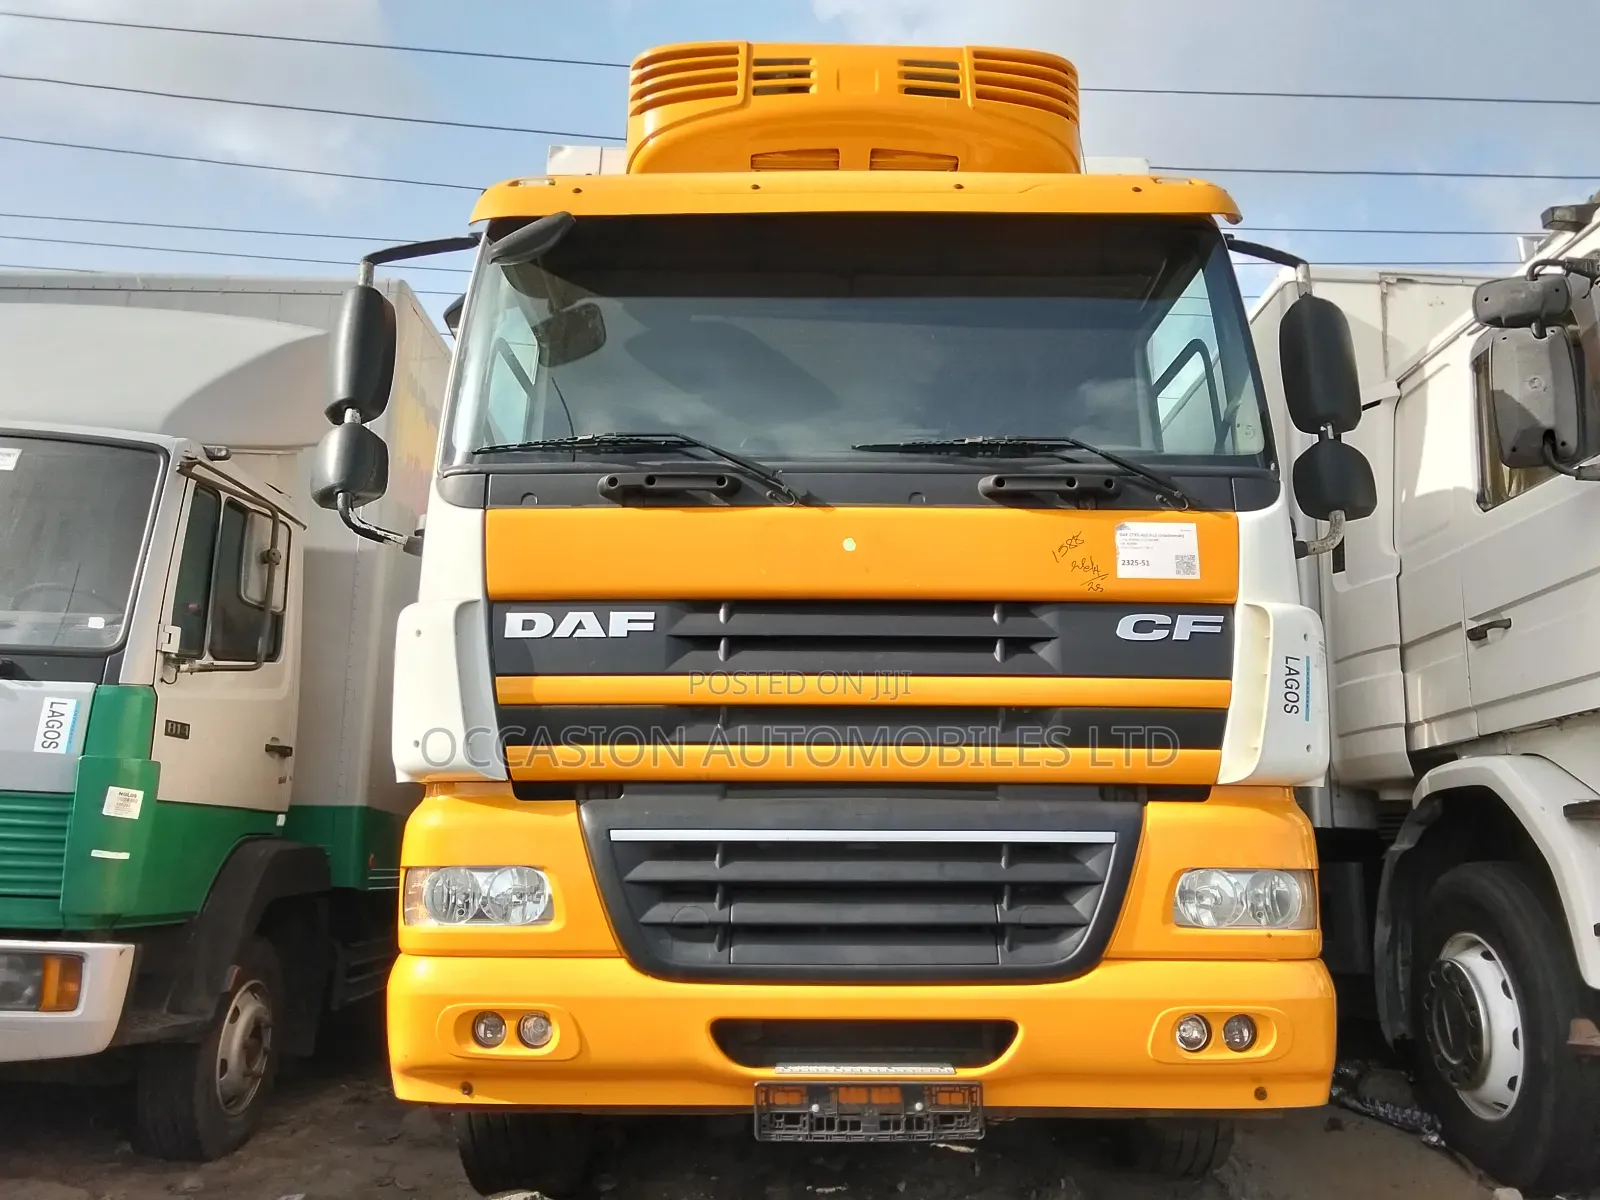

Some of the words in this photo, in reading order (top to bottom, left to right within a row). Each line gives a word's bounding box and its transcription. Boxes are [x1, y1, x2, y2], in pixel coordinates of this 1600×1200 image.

[1121, 559, 1150, 567] 2325-51
[504, 611, 656, 639] DAF
[1116, 614, 1224, 642] CF
[1283, 656, 1300, 714] LAGOS
[41, 701, 68, 749] LAGOS
